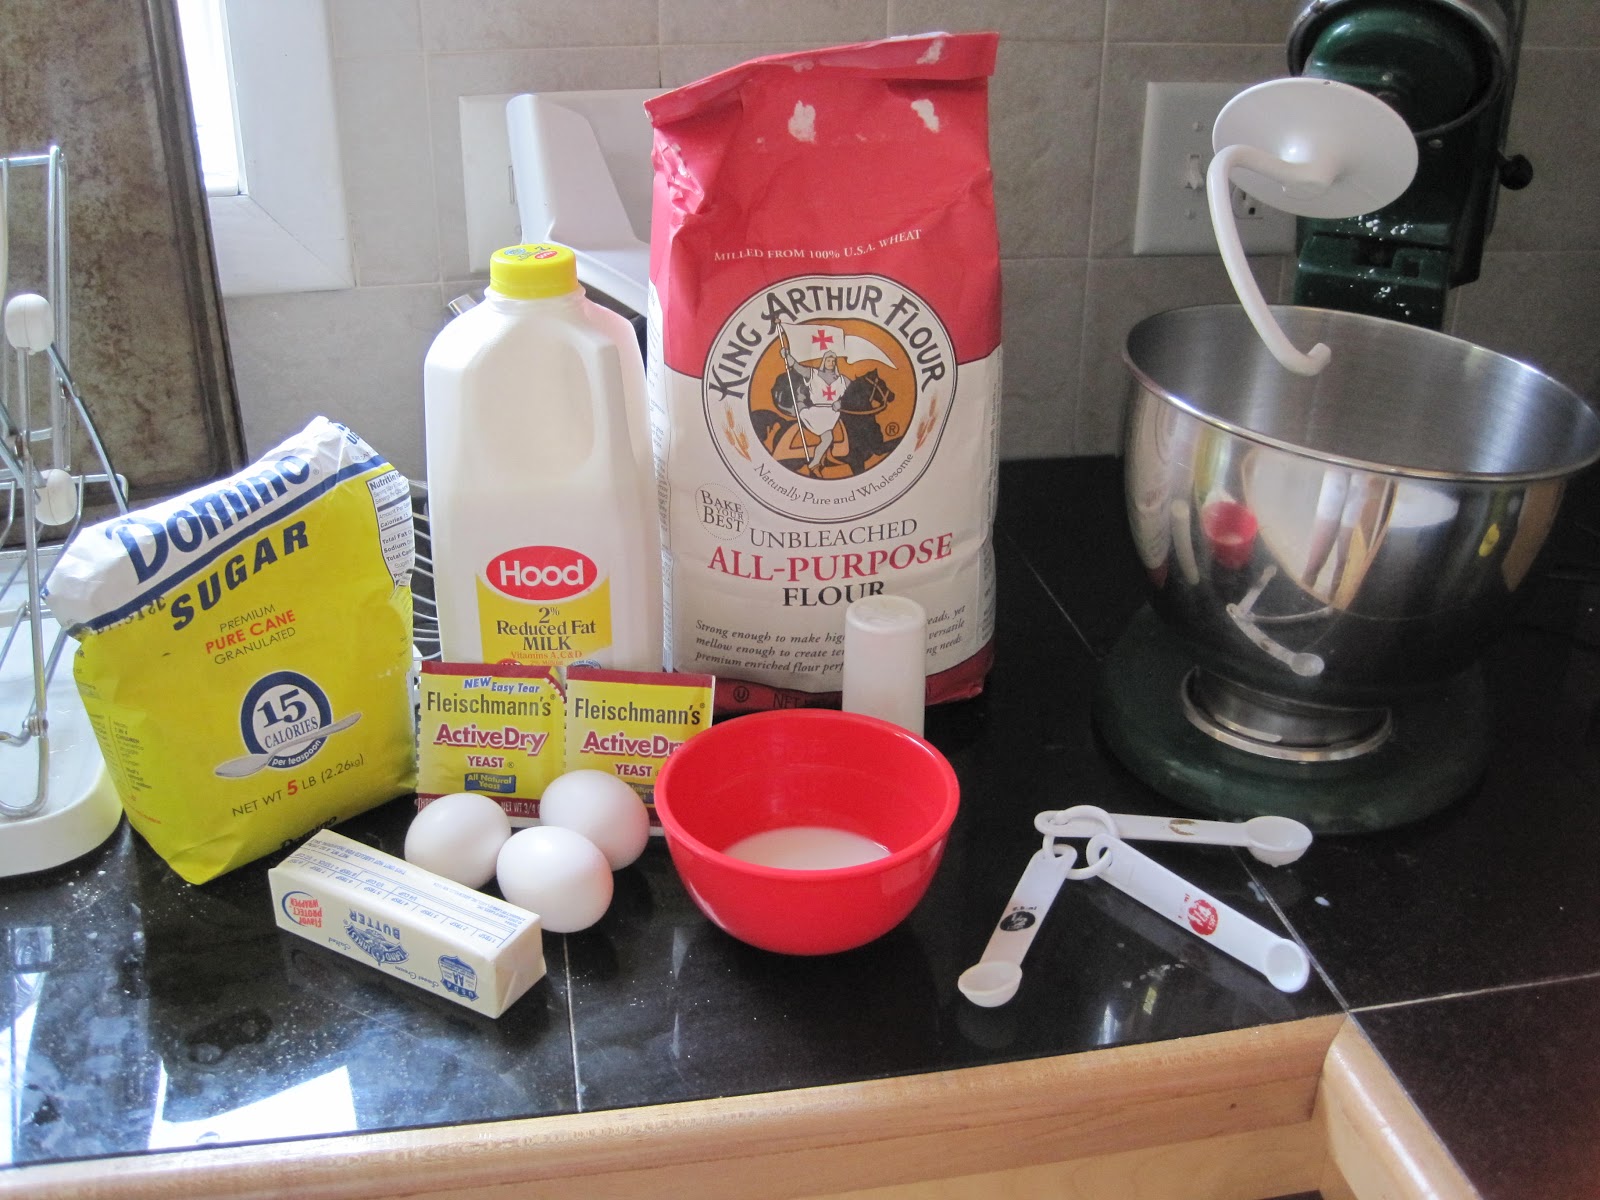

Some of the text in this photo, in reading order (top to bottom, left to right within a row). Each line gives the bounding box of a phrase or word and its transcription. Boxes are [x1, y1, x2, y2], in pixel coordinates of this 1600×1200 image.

[714, 229, 922, 261] MILLED FROM 100% U.S.A. WHEAT
[708, 321, 763, 402] KING
[761, 285, 883, 335] ARTHUR
[884, 294, 946, 393] FLOUR
[753, 453, 914, 505] Naturally Pure and Wholesome
[700, 490, 741, 513] BAKE
[106, 455, 311, 584] Domino
[380, 516, 403, 529] Calories
[703, 505, 744, 532] BEST
[716, 507, 743, 521] YOUR
[749, 518, 918, 549] UNBLEACHED
[383, 542, 407, 554] Sodium
[707, 532, 953, 582] ALL-PURPOSE
[170, 520, 310, 631] SUGAR
[500, 559, 584, 587] Hood
[782, 580, 885, 607] FLOUR
[220, 604, 276, 632] PREMIUM
[538, 607, 560, 624] 2%
[952, 605, 966, 620] yet
[205, 610, 296, 655] PURE CANE
[496, 619, 597, 636] Reduced Fat
[695, 619, 845, 645] Strong enough to make hig
[929, 618, 965, 640] versatile
[214, 626, 296, 665] GRANULATED
[523, 636, 572, 651] MILK
[695, 637, 733, 651] mellow
[736, 647, 776, 658] enough
[779, 649, 791, 657] to
[794, 650, 828, 658] create
[926, 645, 938, 656] ng
[511, 651, 549, 660] Vitamins
[695, 651, 742, 667] premium
[744, 660, 791, 672] enriched
[791, 661, 821, 674] flour
[464, 677, 491, 689] NEW
[491, 682, 540, 695] Easy Tear
[257, 688, 307, 729] 15
[427, 691, 552, 717] Fleischmann's
[575, 697, 701, 725] Fleischmann's
[264, 716, 319, 749] CALORIES
[271, 739, 321, 766] per teaspoon
[467, 755, 505, 768] YEAST
[467, 774, 512, 785] All Natural
[615, 763, 652, 777] YEAST
[232, 753, 364, 817] NET WT 5 LB (2.26kg)
[478, 780, 501, 790] Yeast
[355, 852, 376, 864] LABELED
[290, 897, 319, 909] WRAPPER
[292, 907, 323, 918] PROTECT
[299, 917, 322, 928] Flavor
[349, 908, 400, 940] BUTTER
[328, 937, 352, 951] Salted
[446, 981, 475, 998] USDA
[452, 972, 464, 988] AA
